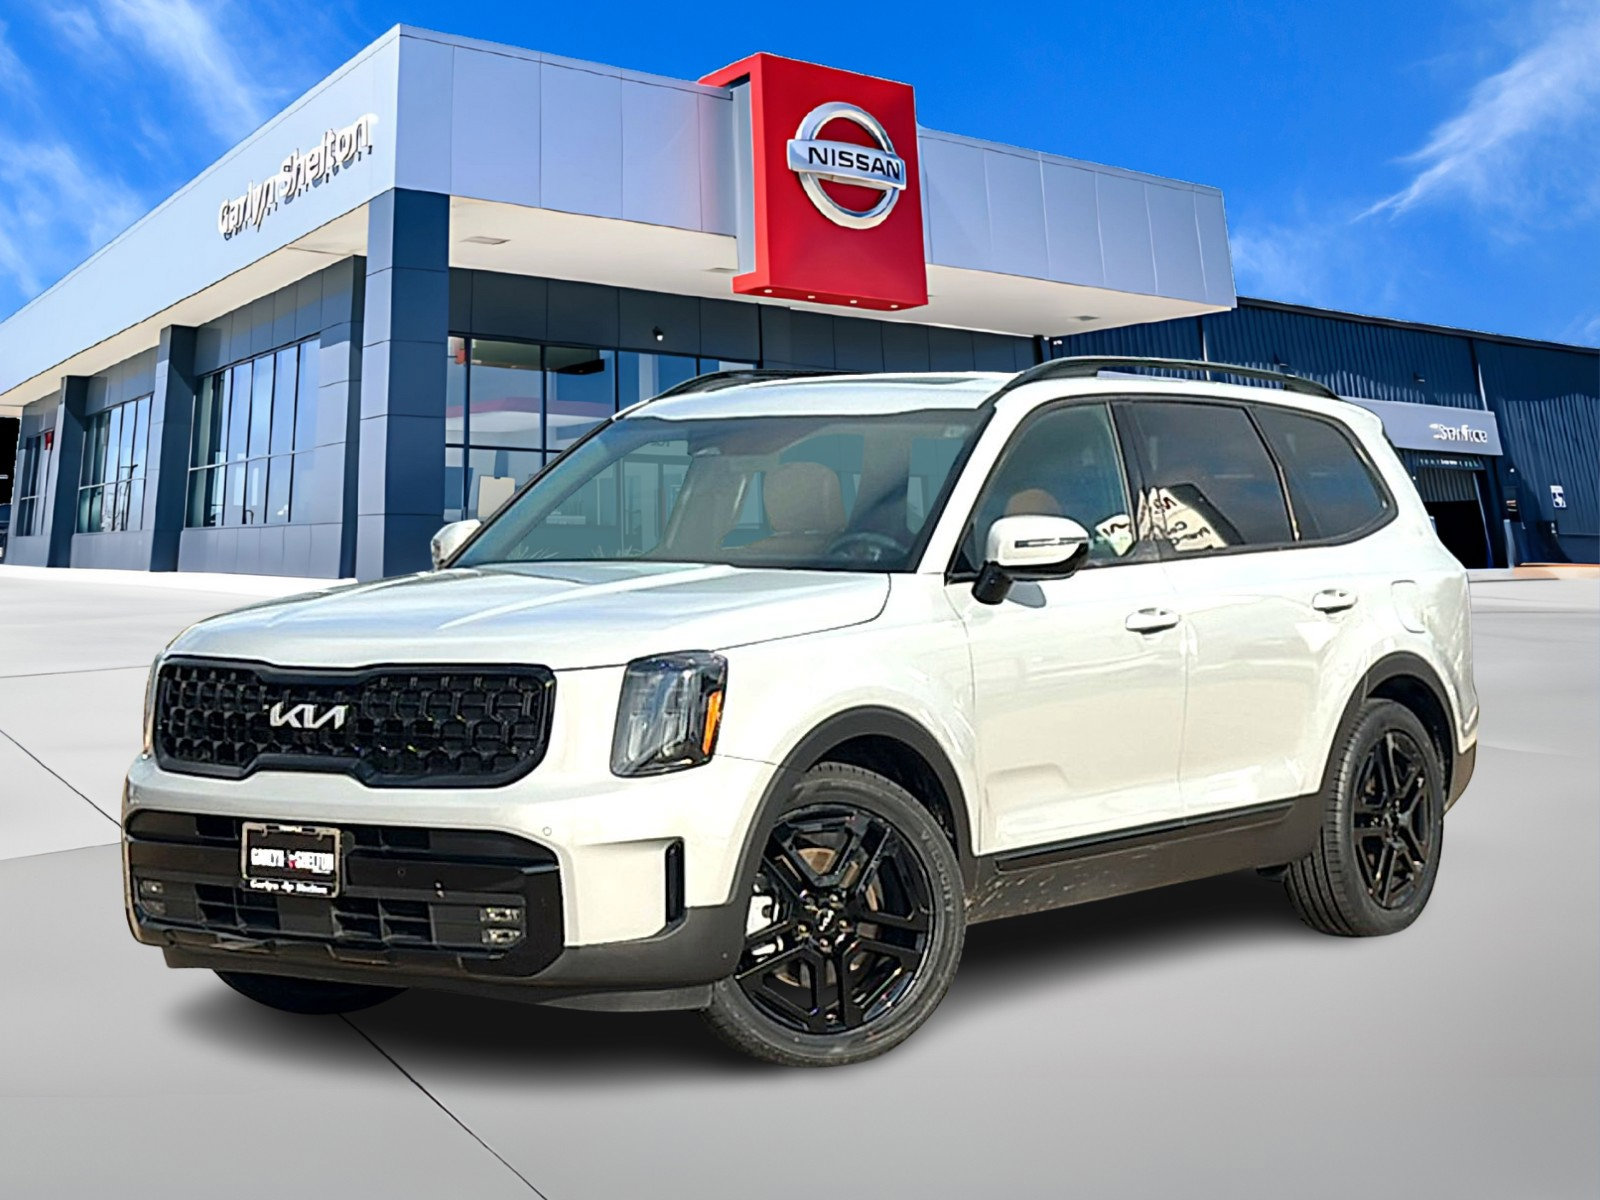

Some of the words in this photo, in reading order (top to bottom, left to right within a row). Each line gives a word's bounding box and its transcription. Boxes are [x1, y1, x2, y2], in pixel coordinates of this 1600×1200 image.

[279, 112, 374, 205] Shelton
[807, 146, 900, 180] NISSAN
[269, 701, 349, 730] KIA
